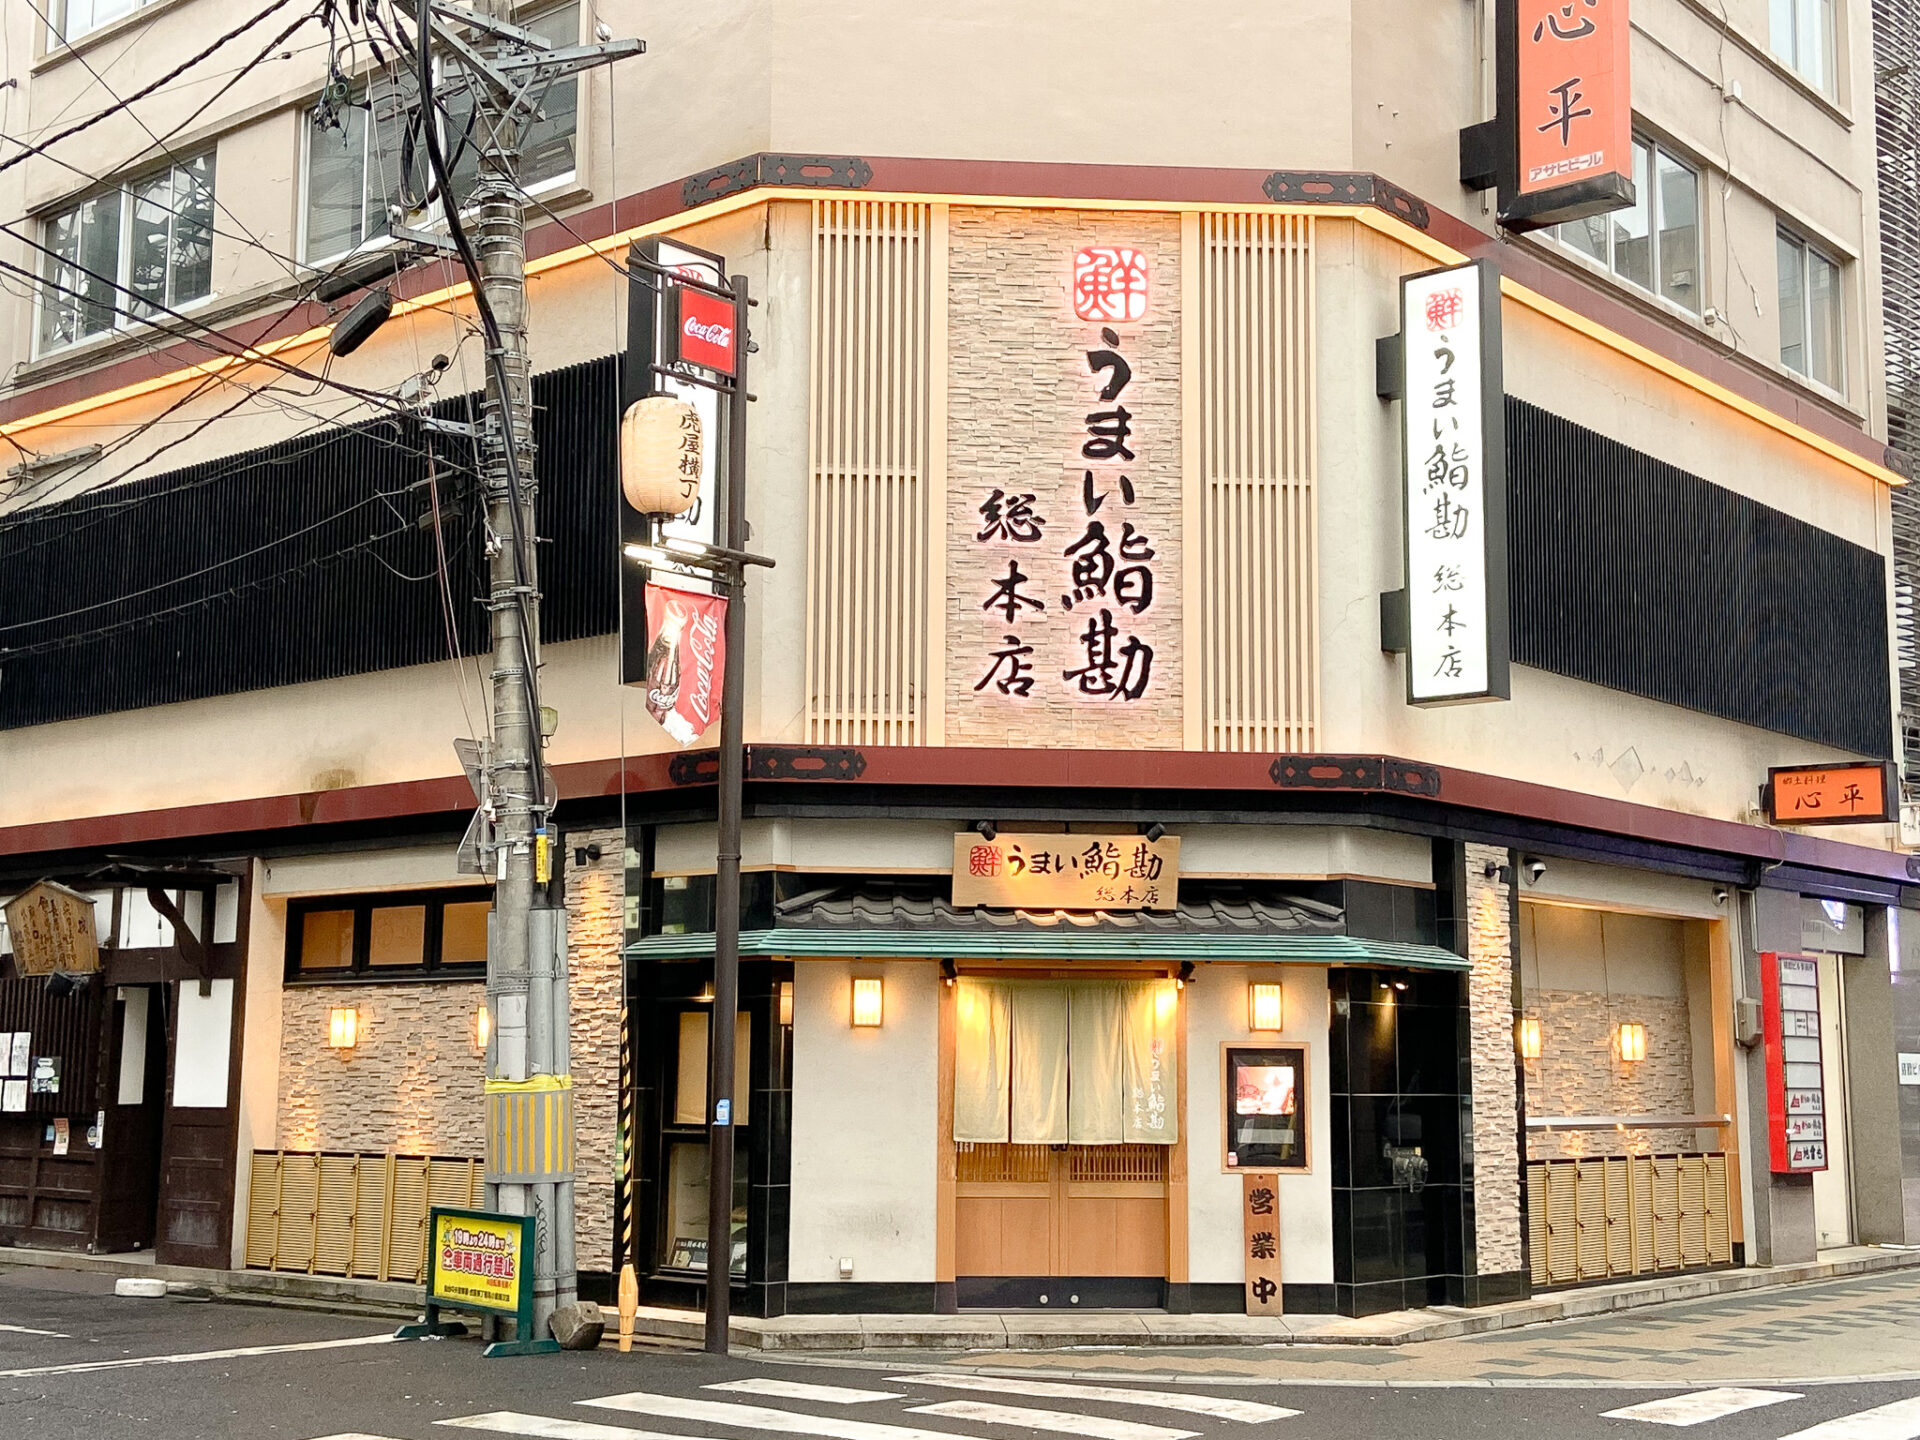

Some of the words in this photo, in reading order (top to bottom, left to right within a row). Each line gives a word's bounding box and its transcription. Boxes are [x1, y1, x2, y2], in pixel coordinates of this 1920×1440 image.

[1533, 0, 1596, 147] 心平
[1530, 152, 1602, 181] アサヒビール
[683, 316, 732, 348] Coca-Cola
[678, 410, 701, 499] 虎屋横丁
[1423, 335, 1469, 540] うまい鮨勘
[1062, 327, 1155, 701] うまい鮨勘
[974, 488, 1046, 698] 総本店
[1432, 564, 1466, 679] 総本店
[689, 603, 718, 725] Coca-Cola
[1794, 783, 1864, 812] 心平
[1007, 841, 1163, 881] うまい鮨勘
[1094, 885, 1160, 905] 総本店
[443, 1247, 515, 1279] 全車両通行禁止
[1249, 1187, 1277, 1305] 営業中
